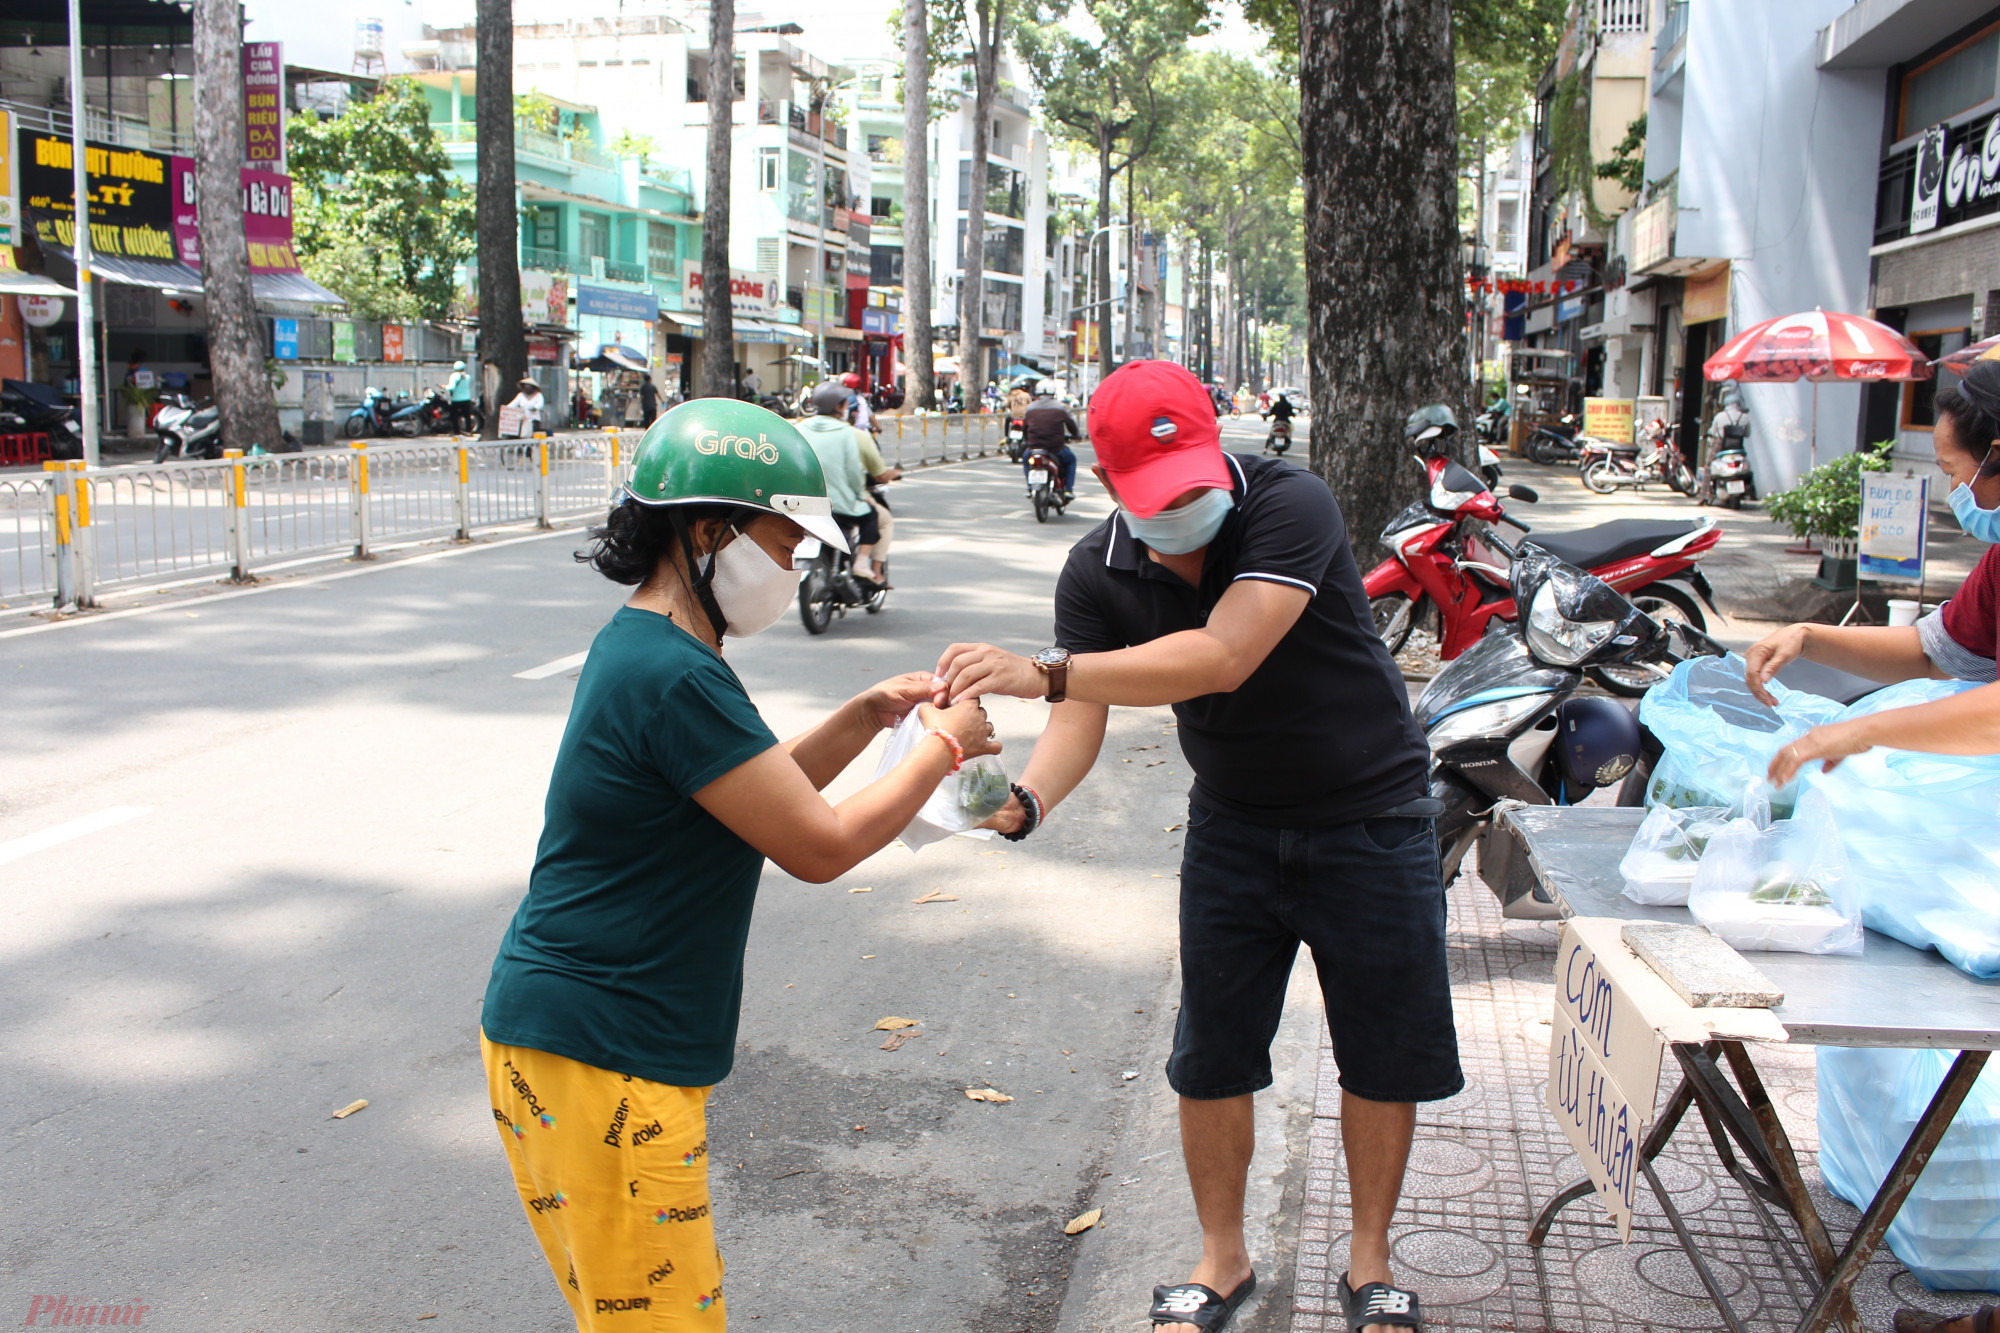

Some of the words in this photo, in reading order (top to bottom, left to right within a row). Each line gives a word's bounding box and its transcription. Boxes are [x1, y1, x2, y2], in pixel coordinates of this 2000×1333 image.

[250, 60, 273, 72] CUA
[35, 136, 73, 169] BÚN
[85, 147, 108, 178] HỊT
[250, 181, 268, 214] Bà
[270, 185, 289, 218] Dú
[694, 429, 779, 466] Grab
[1460, 759, 1499, 768] HONDA
